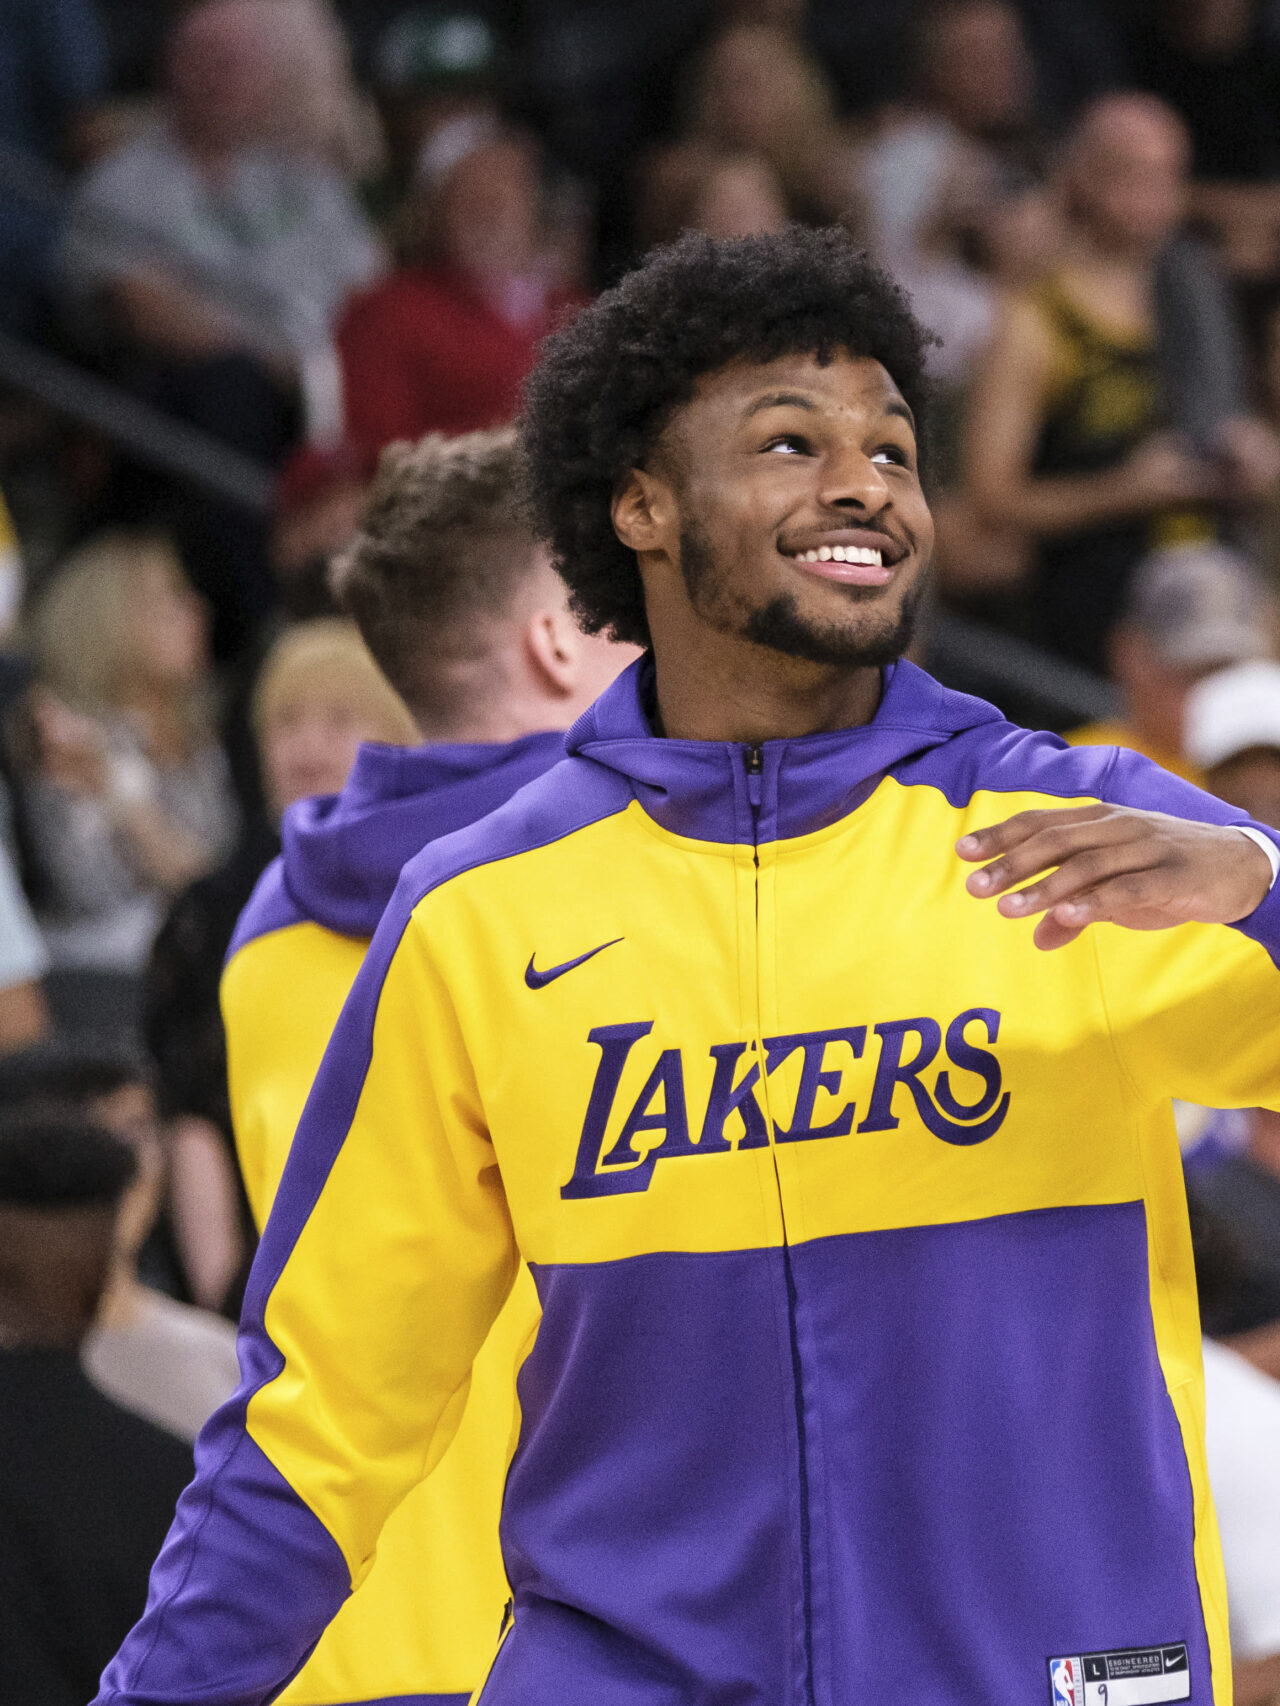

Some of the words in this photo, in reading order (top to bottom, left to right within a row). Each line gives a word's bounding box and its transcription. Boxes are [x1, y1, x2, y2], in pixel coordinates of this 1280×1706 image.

[560, 1007, 1011, 1200] LAKERS
[1093, 1664, 1100, 1675] L
[1108, 1655, 1160, 1667] ENGINEERED
[1098, 1684, 1107, 1706] 9
